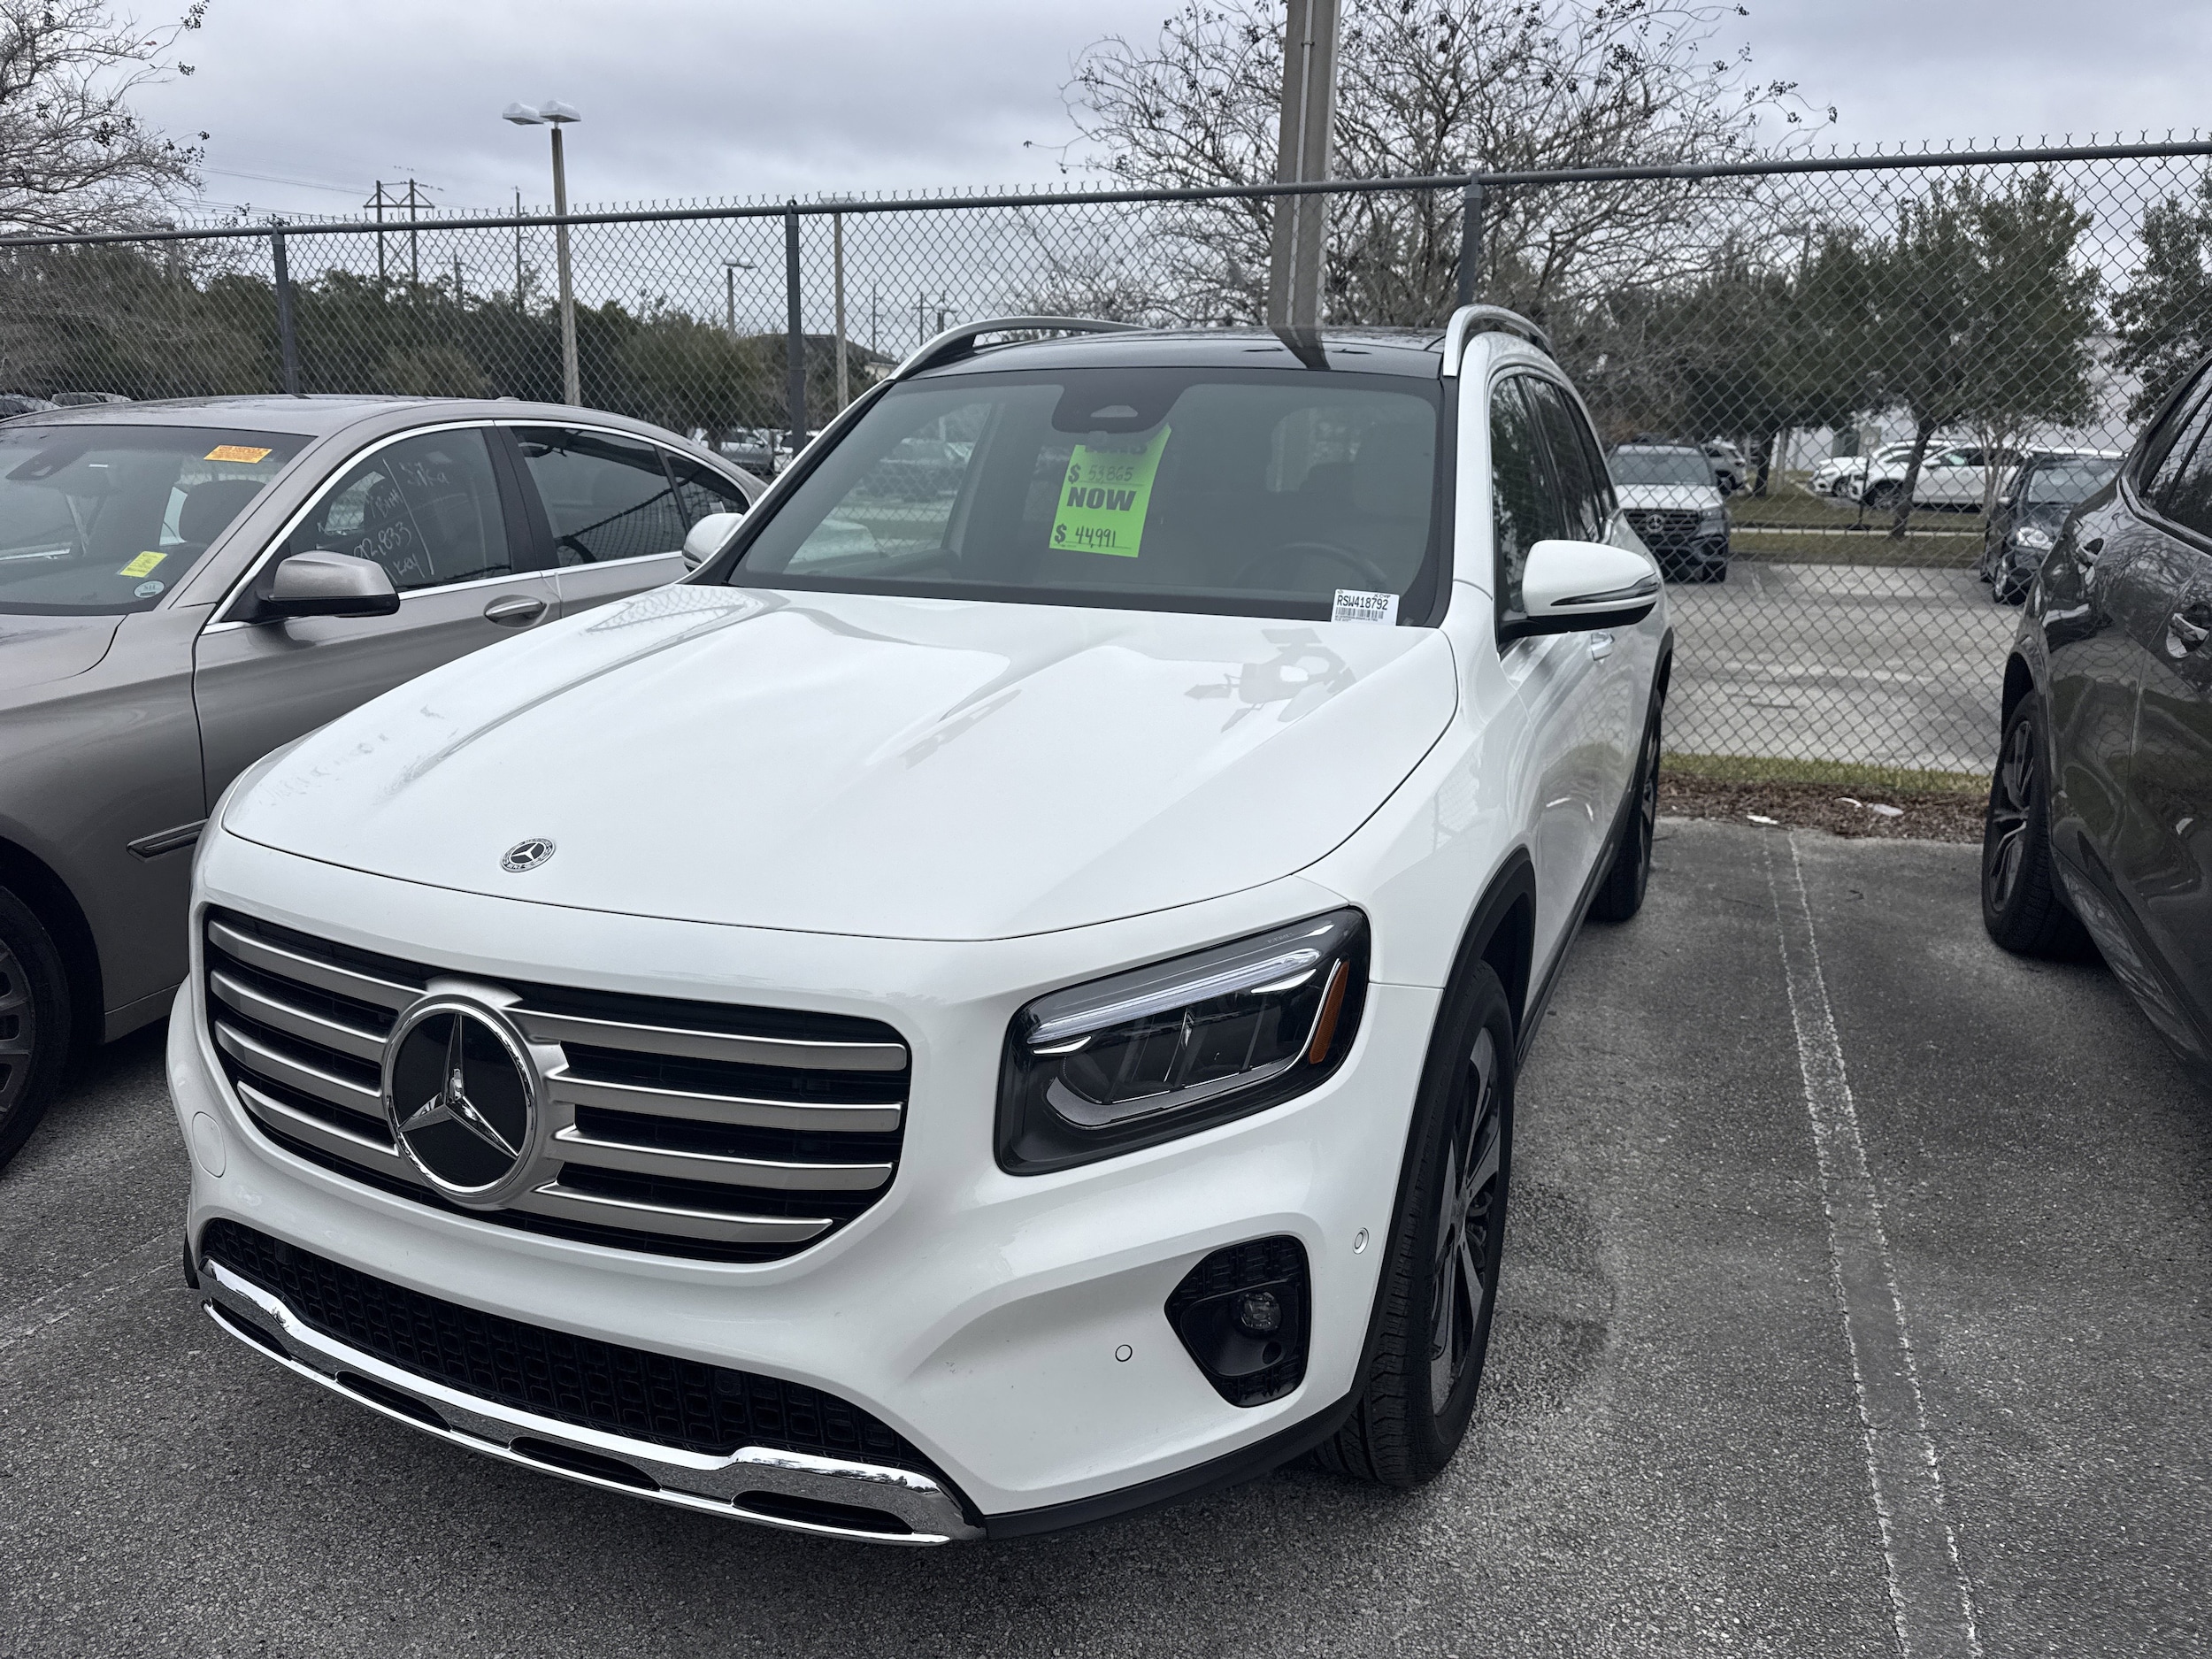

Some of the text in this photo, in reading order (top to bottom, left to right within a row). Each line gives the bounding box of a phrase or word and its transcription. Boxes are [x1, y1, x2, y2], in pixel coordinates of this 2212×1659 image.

[1068, 463, 1134, 484] $ 53,865
[1066, 487, 1137, 511] NOW
[1054, 523, 1117, 548] $ 44,991
[1336, 595, 1389, 611] RSW418792
